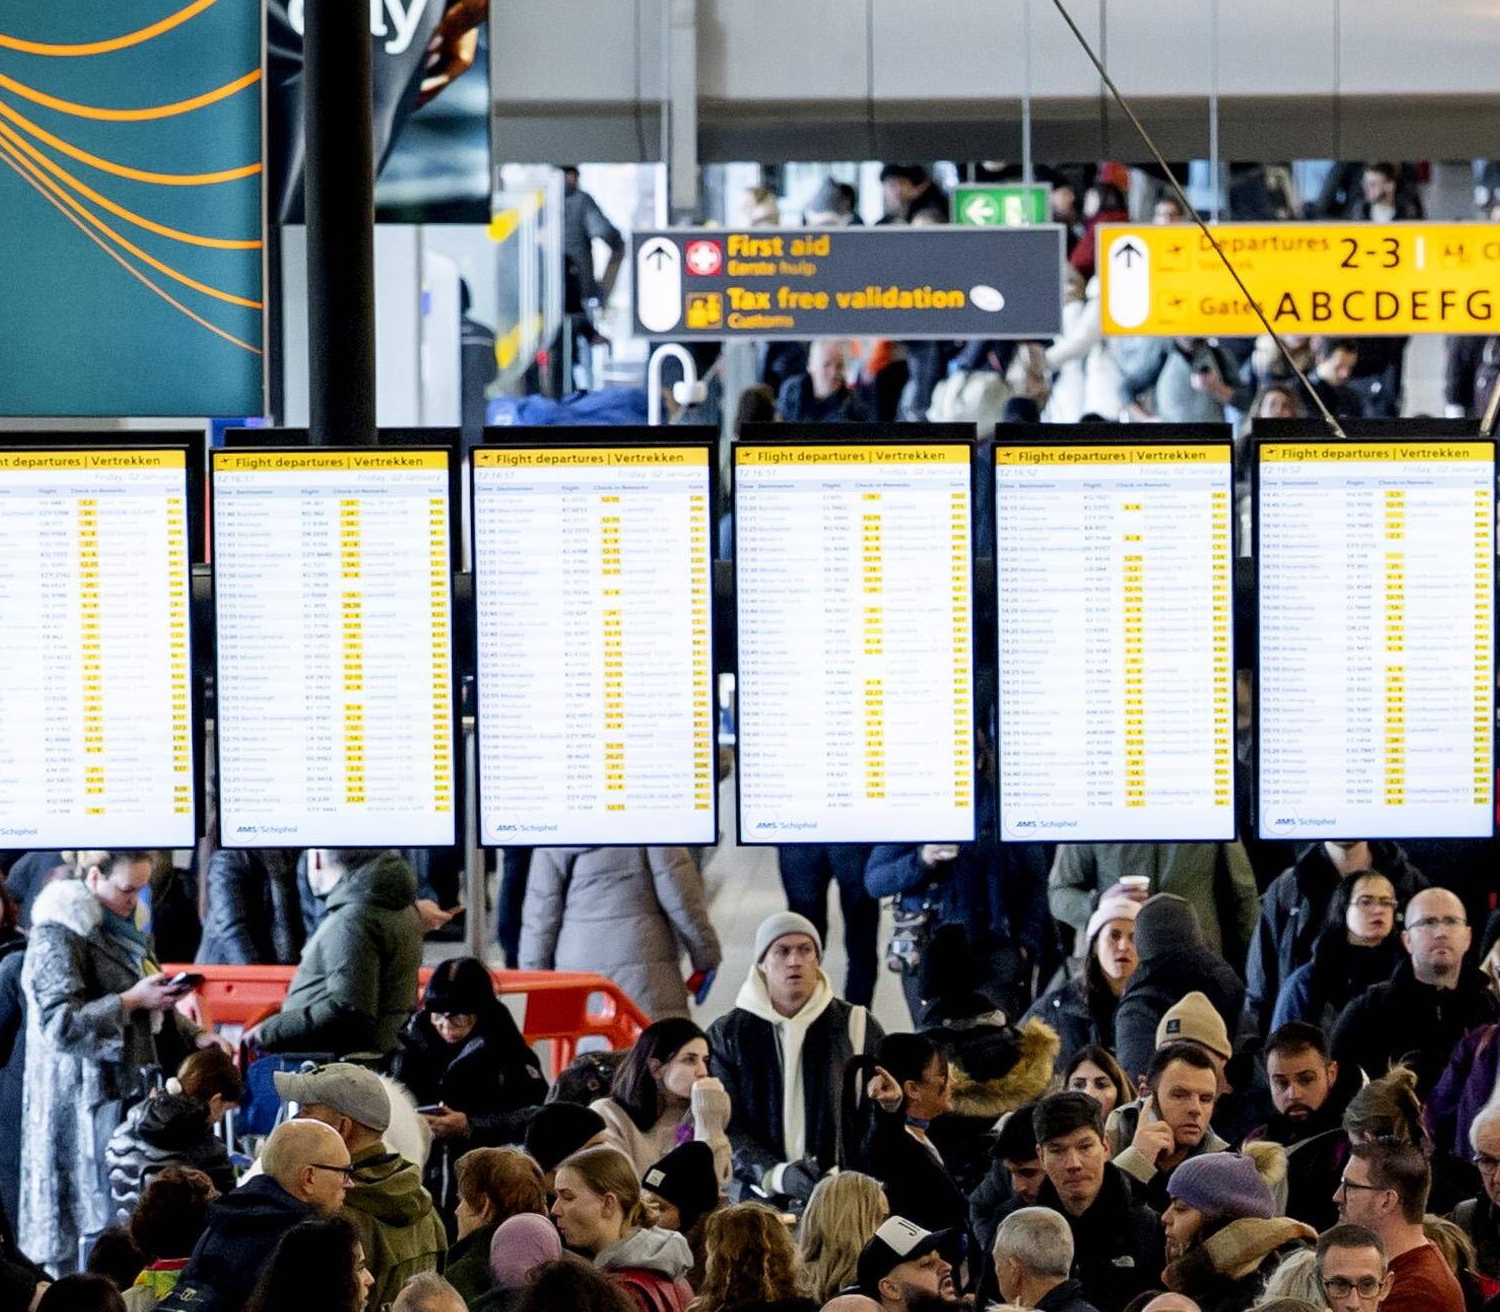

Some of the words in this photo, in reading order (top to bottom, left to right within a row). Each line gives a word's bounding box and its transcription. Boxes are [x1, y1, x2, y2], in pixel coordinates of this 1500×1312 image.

[727, 235, 783, 257] First
[791, 234, 830, 257] aid
[1200, 235, 1331, 253] Departures
[1341, 237, 1401, 269] 2-3
[727, 287, 771, 310] Tax
[777, 287, 829, 310] free
[836, 285, 966, 309] validation
[496, 454, 533, 467] Flight
[537, 454, 604, 467] departures
[615, 454, 684, 464] Vertrekken
[757, 451, 794, 464] Flight
[798, 451, 865, 464] departures
[876, 451, 945, 461] Vertrekken
[1018, 451, 1055, 464] Flight
[1059, 451, 1126, 464] departures
[1137, 451, 1206, 461] Vertrekken
[1281, 449, 1318, 462] Flight
[1322, 449, 1389, 462] departures
[1400, 449, 1469, 459] Vertrekken
[13, 456, 80, 469] departures
[91, 456, 160, 466] Vertrekken
[235, 458, 272, 471] Flight
[276, 458, 343, 471] departures
[354, 458, 423, 468] Vertrekken
